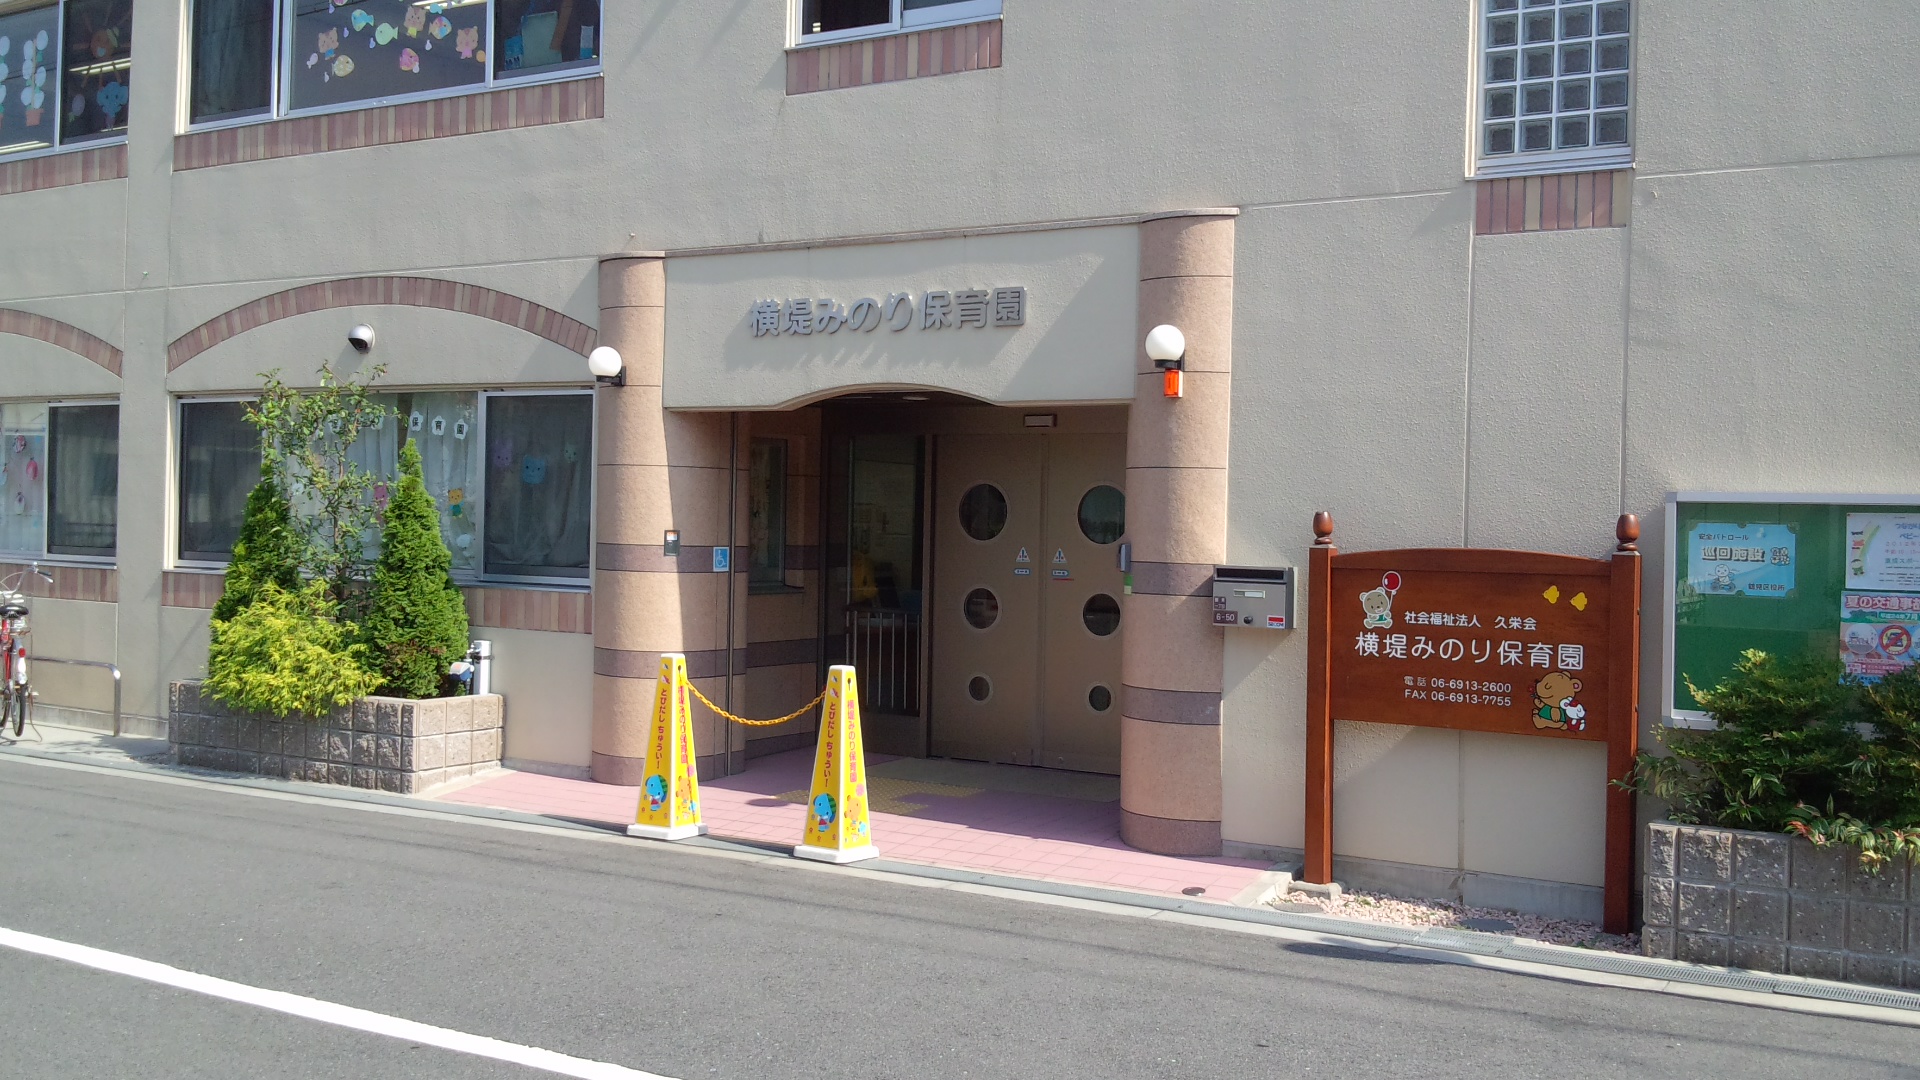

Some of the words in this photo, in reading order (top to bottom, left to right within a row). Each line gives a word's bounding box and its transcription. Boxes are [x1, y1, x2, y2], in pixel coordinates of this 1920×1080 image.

[750, 286, 1027, 337] 横堤みのり保育園
[1698, 533, 1749, 541] 安全パトロール
[1702, 546, 1766, 563] 巡回施設
[1748, 583, 1785, 591] 鶴見区役所
[1216, 613, 1235, 622] 6-50
[1404, 610, 1481, 629] 社会福祉法人
[1494, 616, 1537, 631] 久栄会
[1354, 631, 1584, 670] 横堤みのり保育園
[1403, 675, 1427, 687] 電話
[1431, 677, 1512, 693] 06-6913-2600
[1404, 689, 1427, 700] FAX
[1431, 691, 1512, 707] 06-6913-7755
